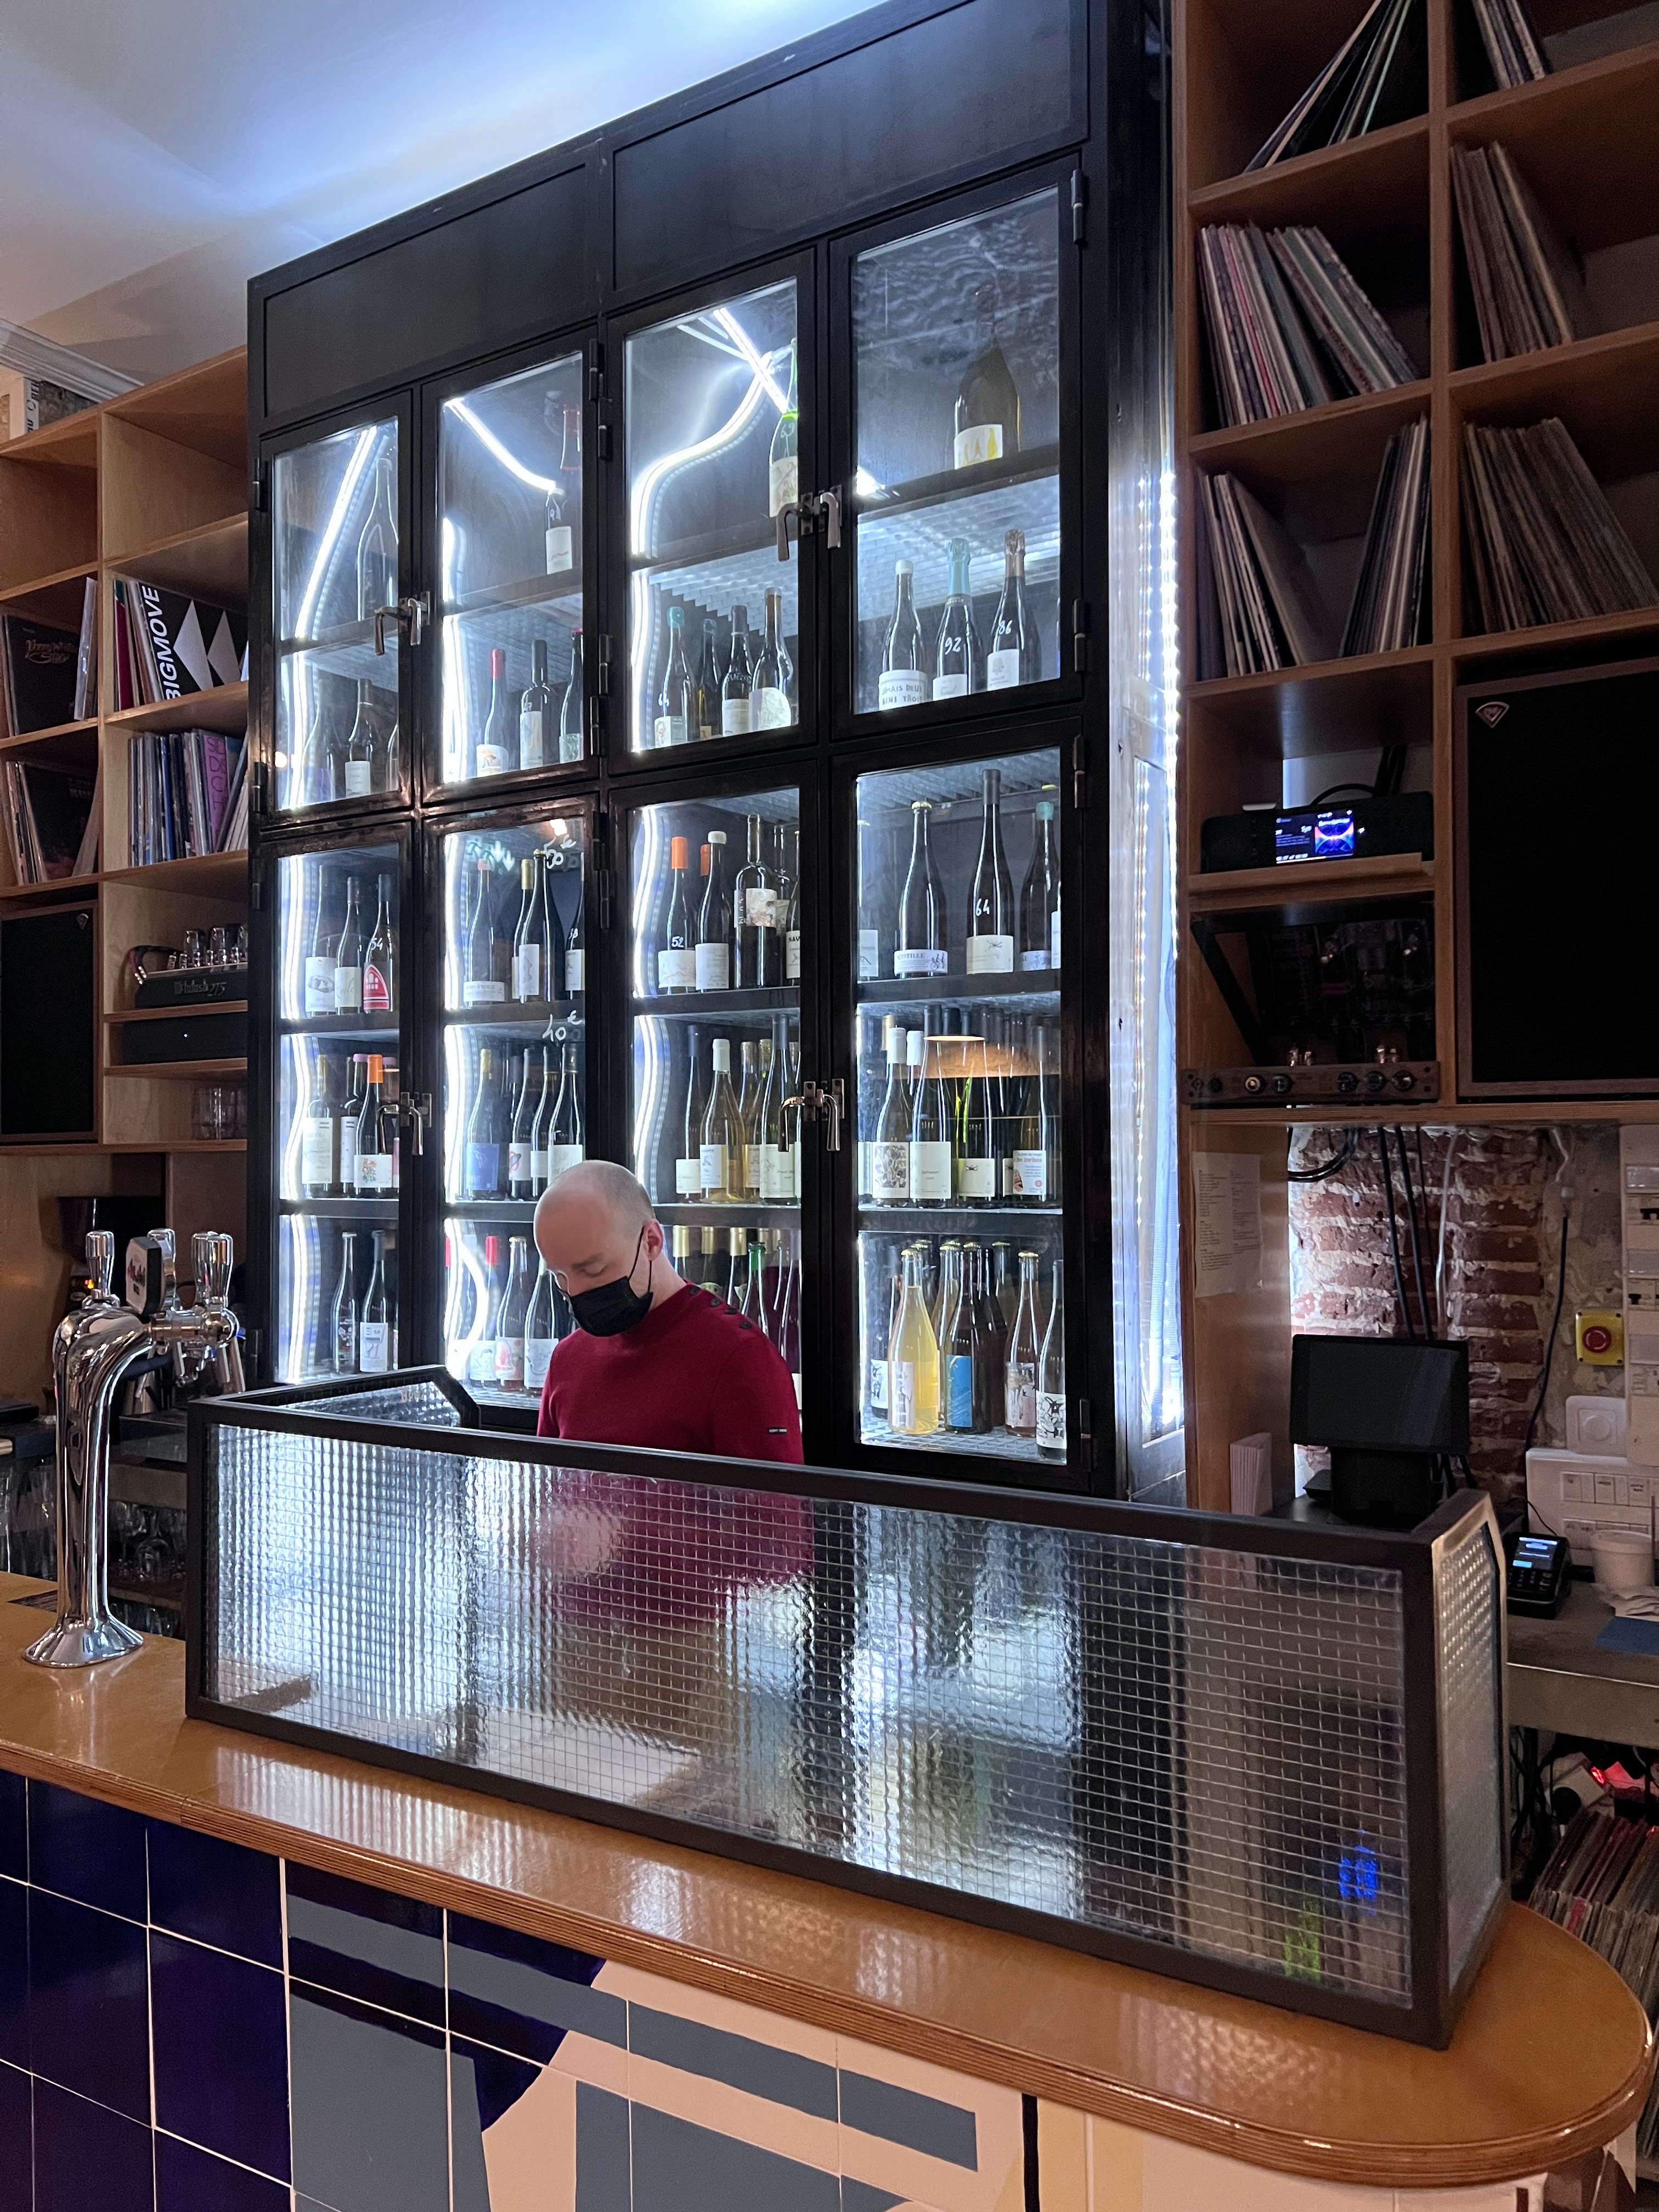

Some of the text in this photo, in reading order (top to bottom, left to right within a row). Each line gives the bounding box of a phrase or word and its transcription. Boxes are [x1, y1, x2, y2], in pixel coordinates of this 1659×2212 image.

[998, 619, 1013, 635] 86
[142, 585, 181, 700] BIGMOVE
[944, 636, 962, 655] 92
[975, 898, 990, 917] 64
[370, 937, 383, 951] 54
[671, 935, 685, 948] 52
